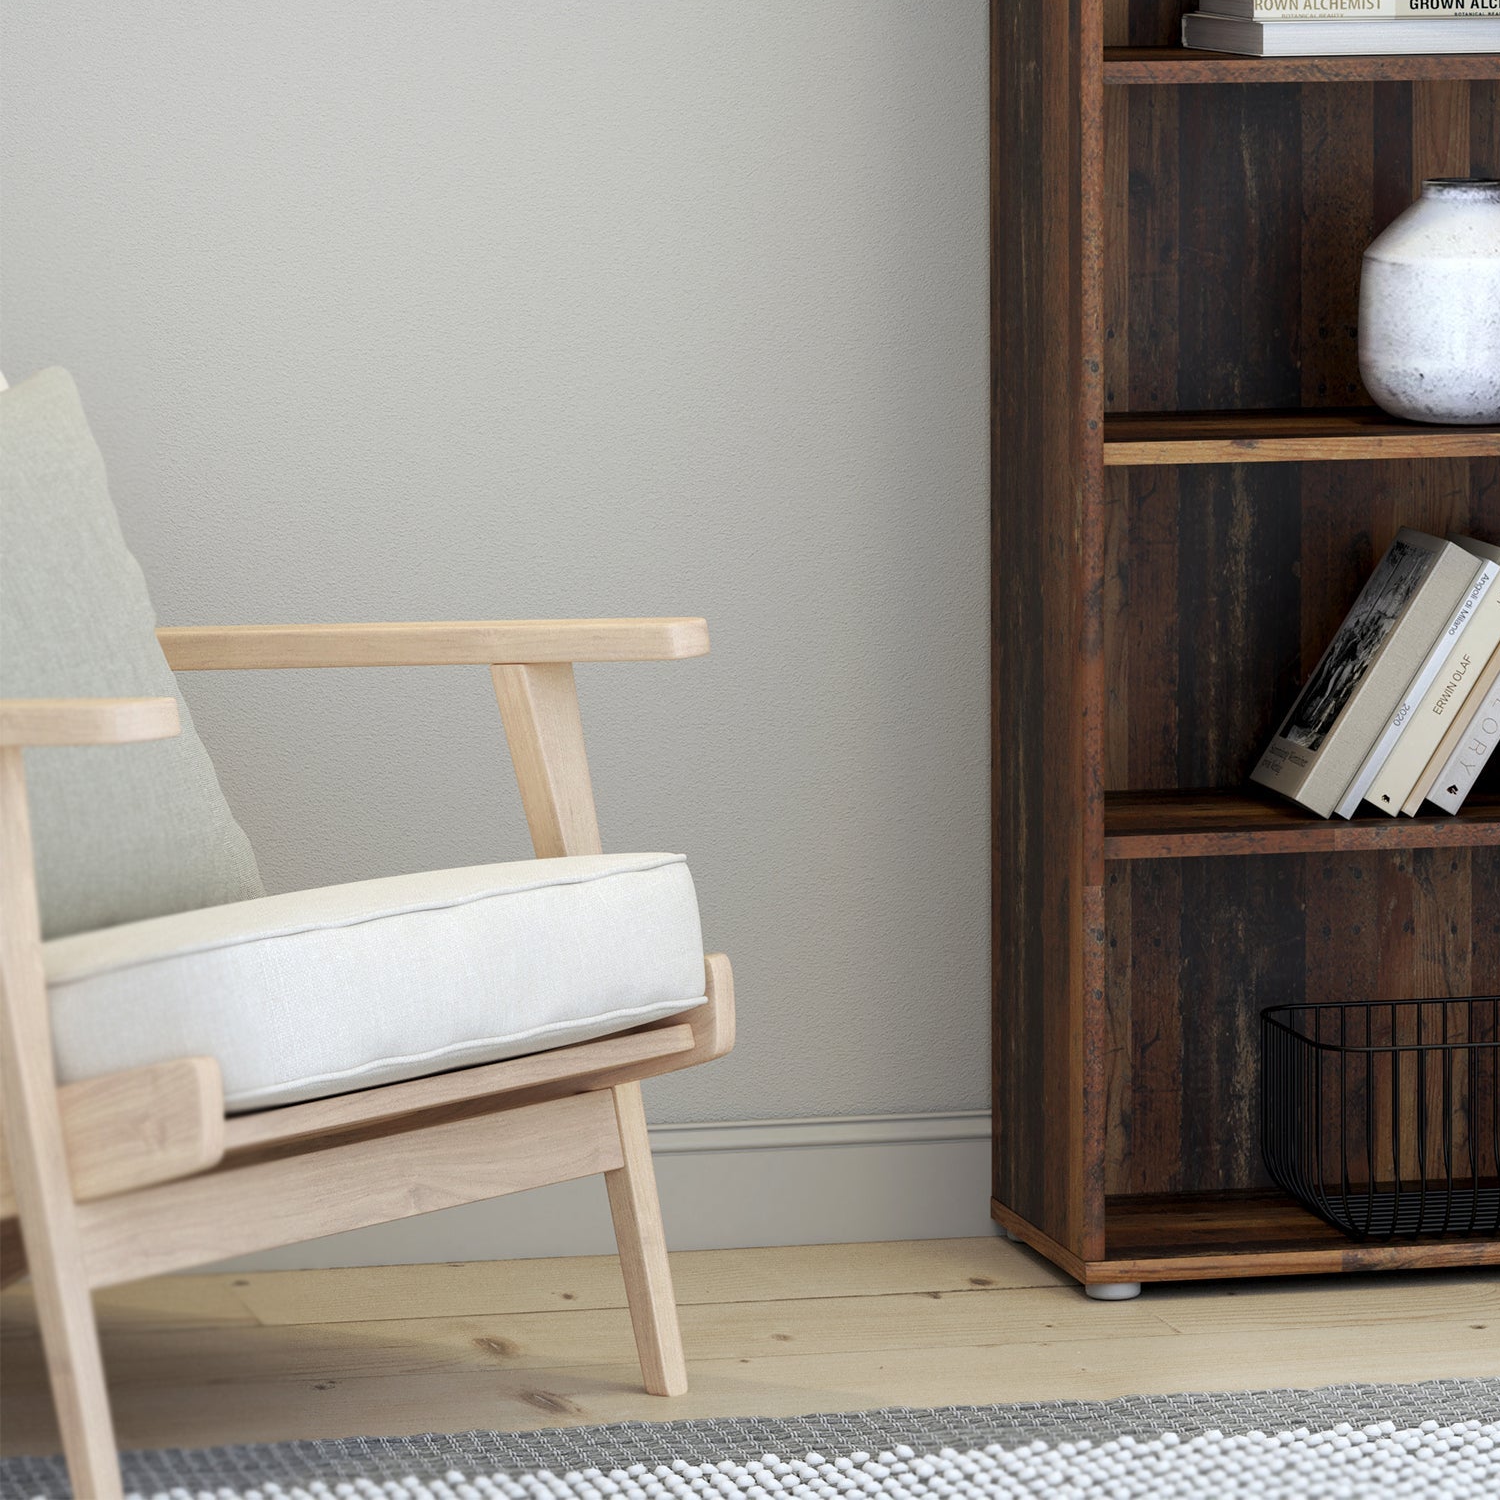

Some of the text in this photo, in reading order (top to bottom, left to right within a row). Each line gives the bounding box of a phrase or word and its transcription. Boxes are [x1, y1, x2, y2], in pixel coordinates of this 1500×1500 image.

[1470, 573, 1490, 600] Angoli
[1448, 608, 1469, 636] Milano
[1432, 653, 1472, 716] ERWIN OLAF
[1393, 703, 1410, 727] 2020
